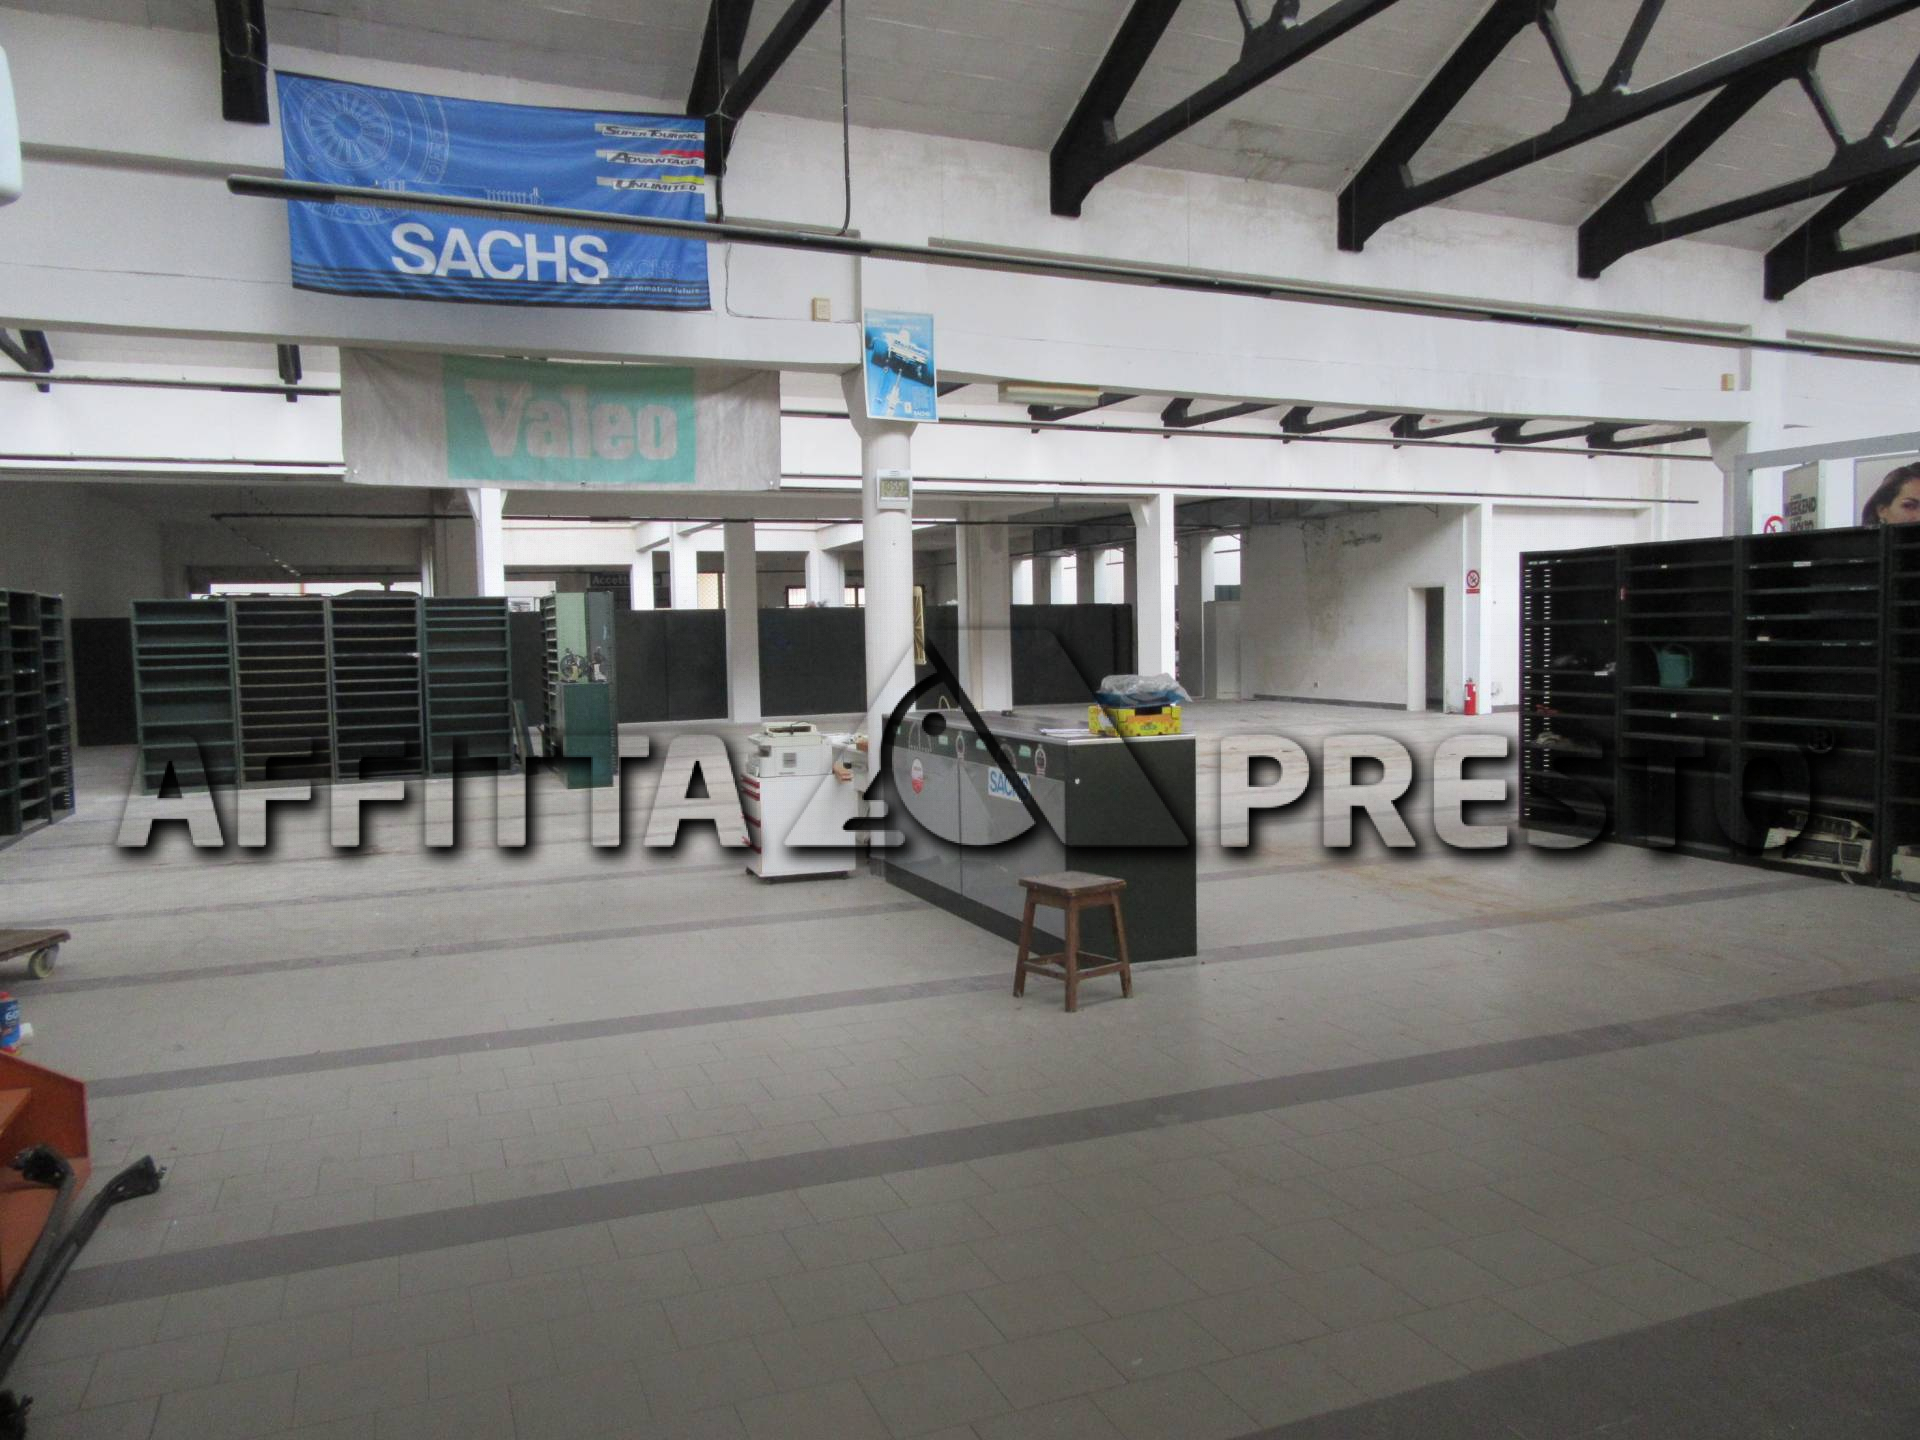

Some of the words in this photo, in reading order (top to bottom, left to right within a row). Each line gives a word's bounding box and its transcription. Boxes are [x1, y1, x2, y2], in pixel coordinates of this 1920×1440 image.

[604, 125, 647, 137] SUPER
[649, 129, 698, 140] TOURING
[608, 152, 698, 165] ADVANTAGE
[615, 179, 697, 192] UNLIMITED
[391, 223, 609, 285] SACHS
[464, 379, 678, 460] Valeo
